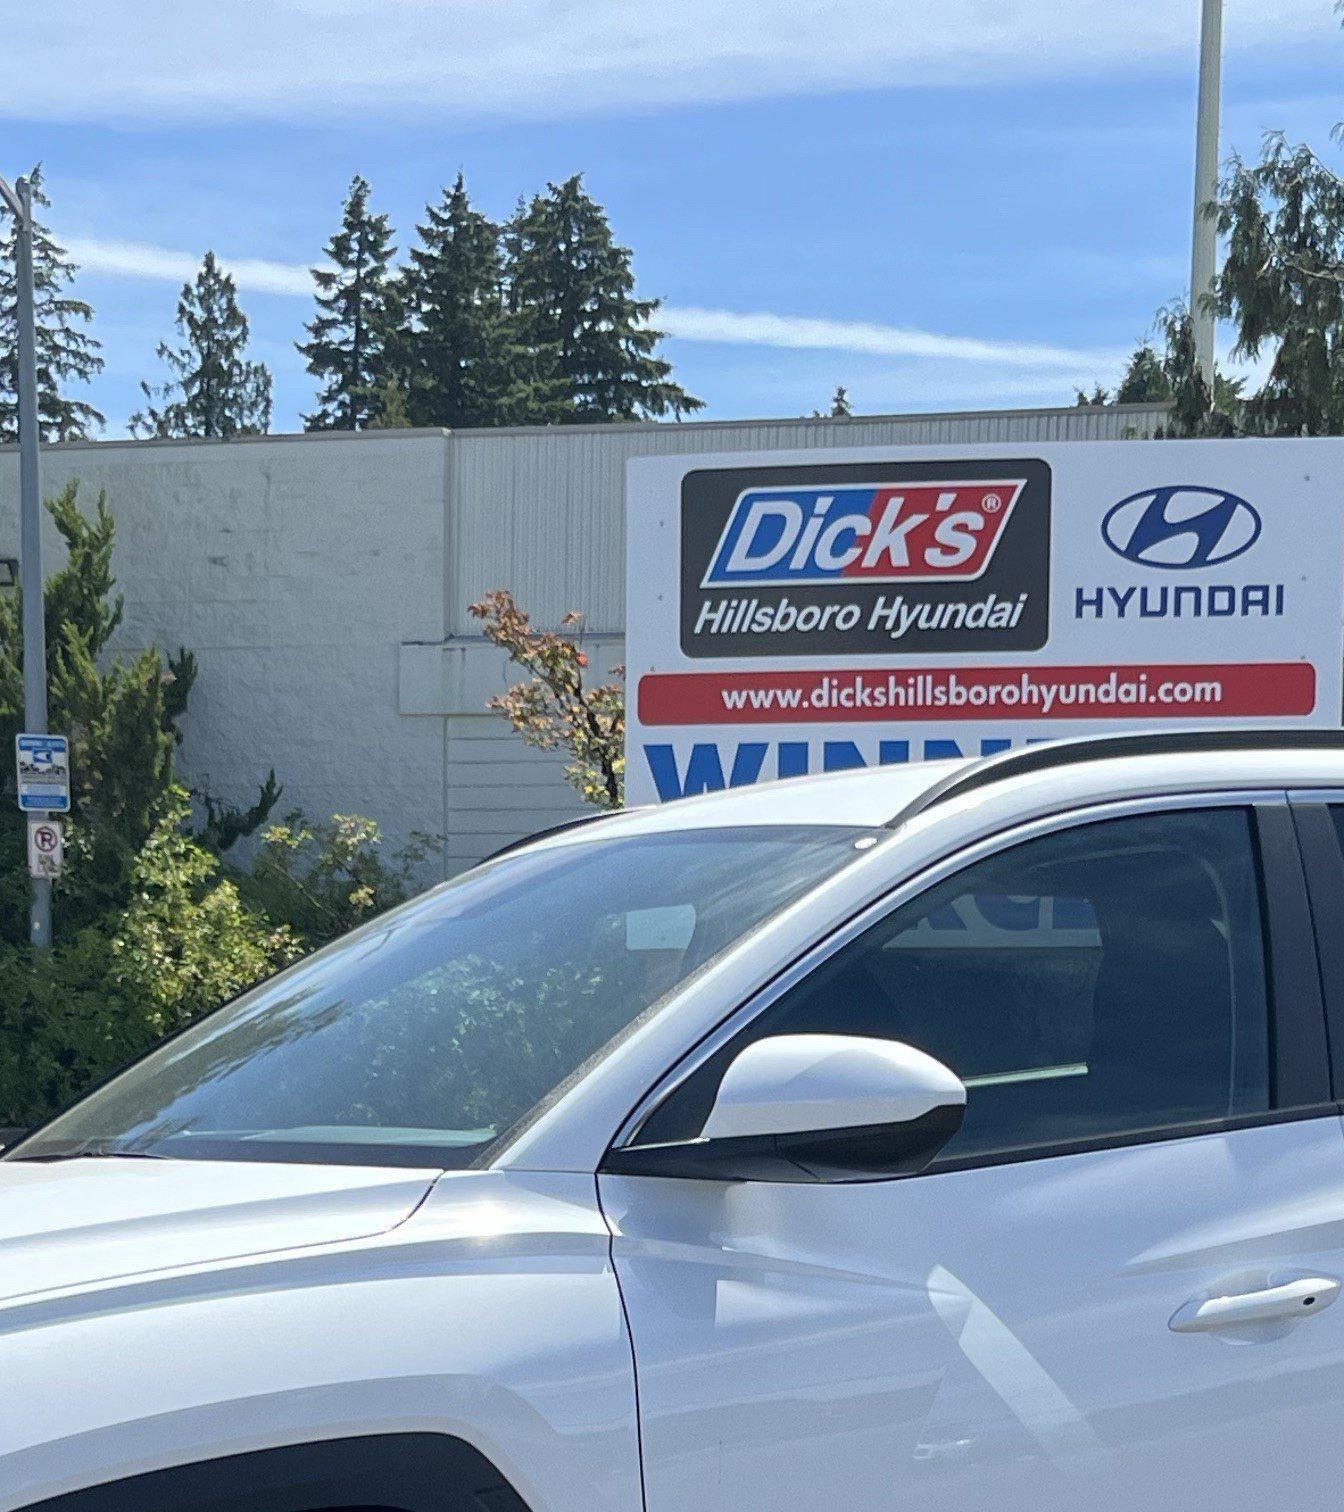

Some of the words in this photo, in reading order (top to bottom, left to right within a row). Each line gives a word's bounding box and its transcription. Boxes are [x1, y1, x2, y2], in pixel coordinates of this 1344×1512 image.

[724, 493, 986, 573] Dick's
[693, 597, 861, 635] Hillsboro
[867, 592, 1029, 640] Hyundai
[1074, 583, 1285, 619] HYUNDAI
[720, 672, 1224, 713] www.dickshillsborohyundai.com
